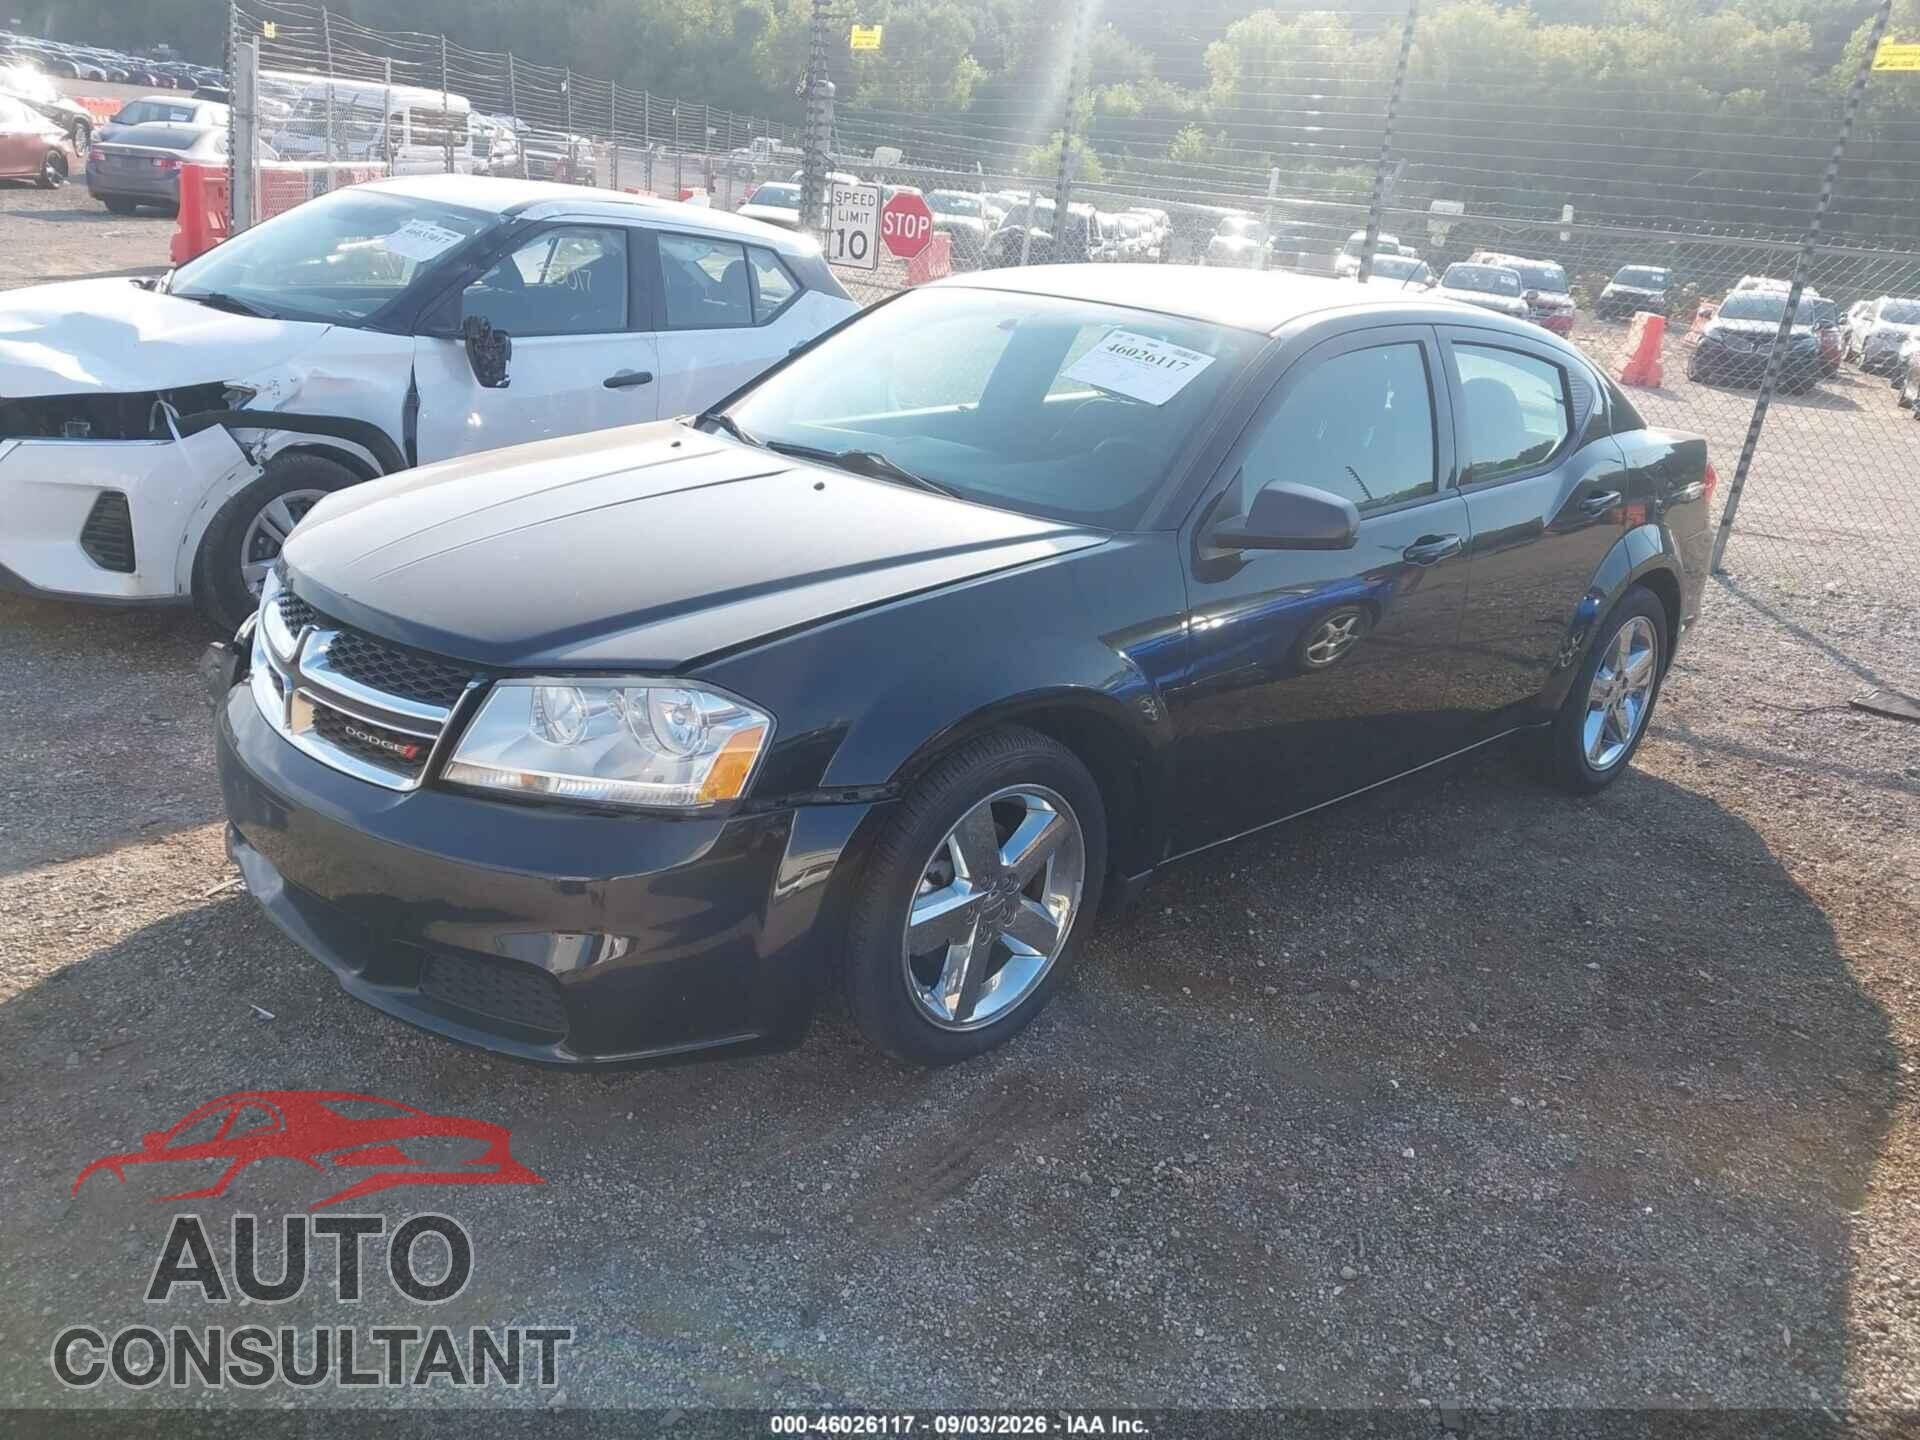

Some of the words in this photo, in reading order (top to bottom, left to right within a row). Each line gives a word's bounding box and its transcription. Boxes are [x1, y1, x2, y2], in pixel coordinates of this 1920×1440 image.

[835, 191, 876, 207] SPEED
[839, 208, 870, 225] LIMIT
[883, 211, 930, 239] STOP
[836, 228, 868, 260] 10
[1106, 343, 1191, 372] 46026117
[345, 725, 408, 755] DODGE
